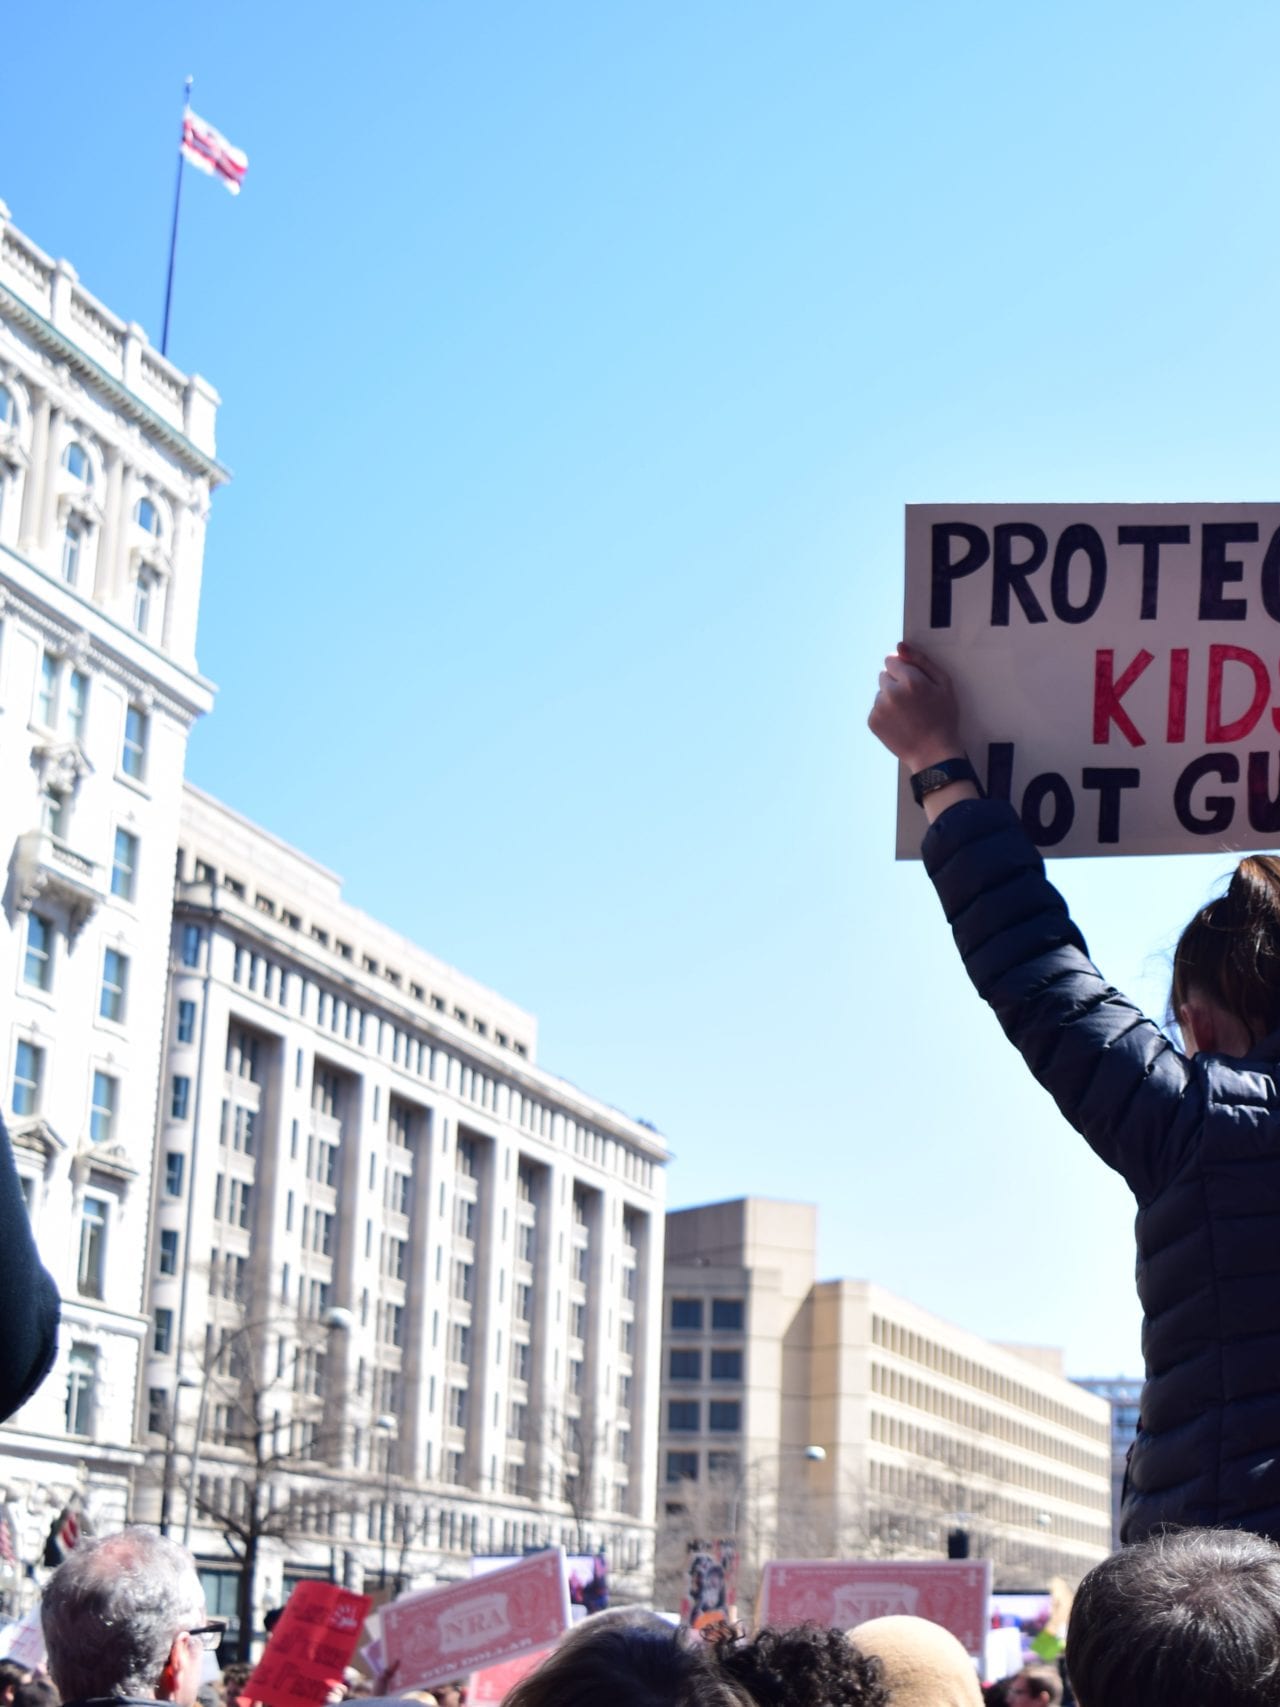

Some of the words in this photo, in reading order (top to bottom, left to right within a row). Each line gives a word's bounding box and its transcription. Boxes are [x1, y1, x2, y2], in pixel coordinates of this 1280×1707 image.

[840, 1599, 910, 1620] NRA
[445, 1607, 504, 1643] NRA
[461, 1637, 533, 1667] DOLLAR
